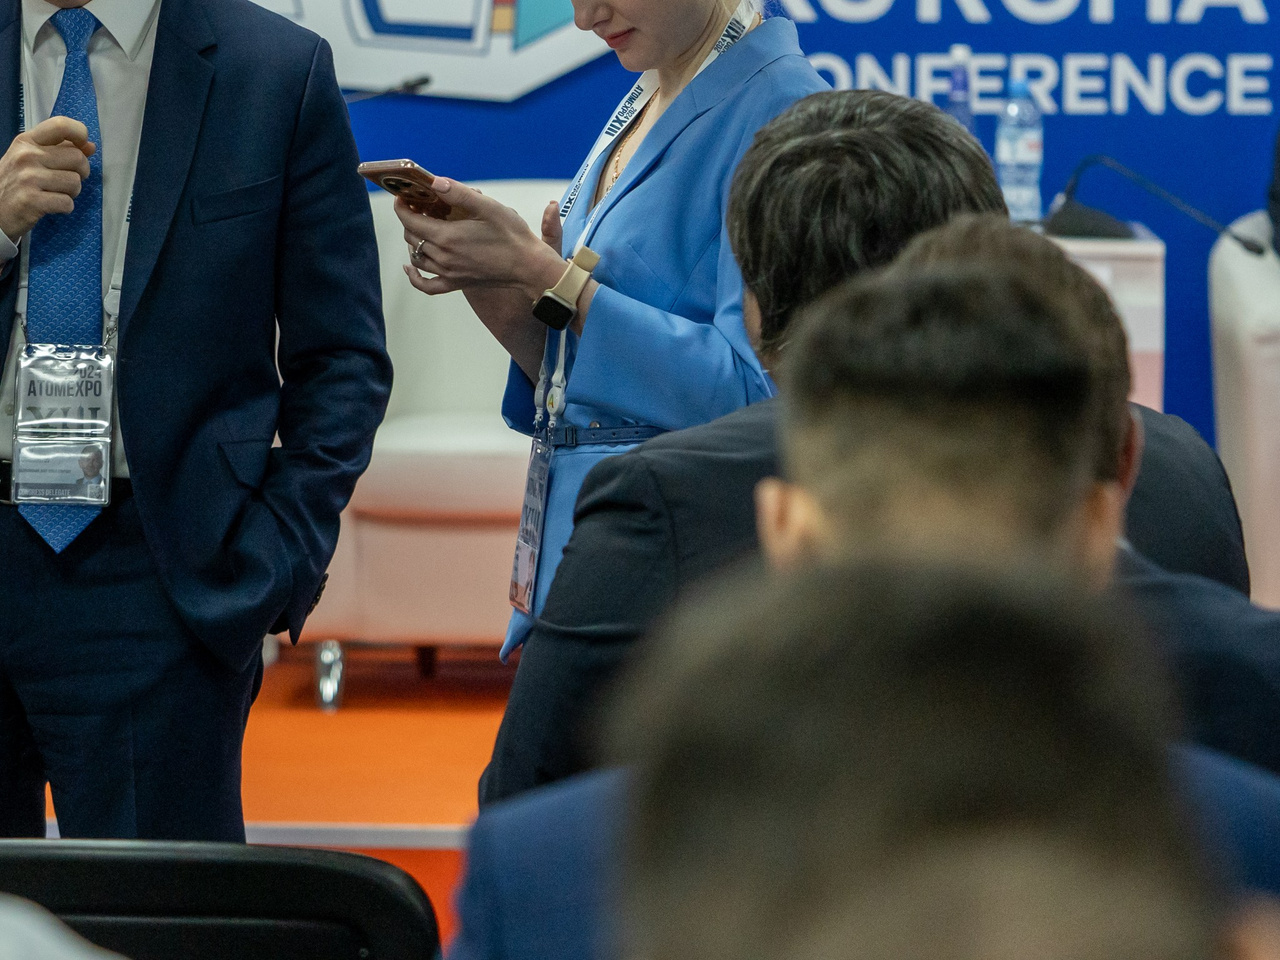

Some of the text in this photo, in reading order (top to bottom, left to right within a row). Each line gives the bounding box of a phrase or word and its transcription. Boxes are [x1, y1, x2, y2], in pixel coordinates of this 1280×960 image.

[806, 52, 1273, 116] ONFERENCE
[604, 84, 644, 137] ATOMEXPO XIII
[623, 106, 637, 120] 2024
[559, 196, 576, 218] XIII
[27, 380, 103, 397] ATOMEXPO
